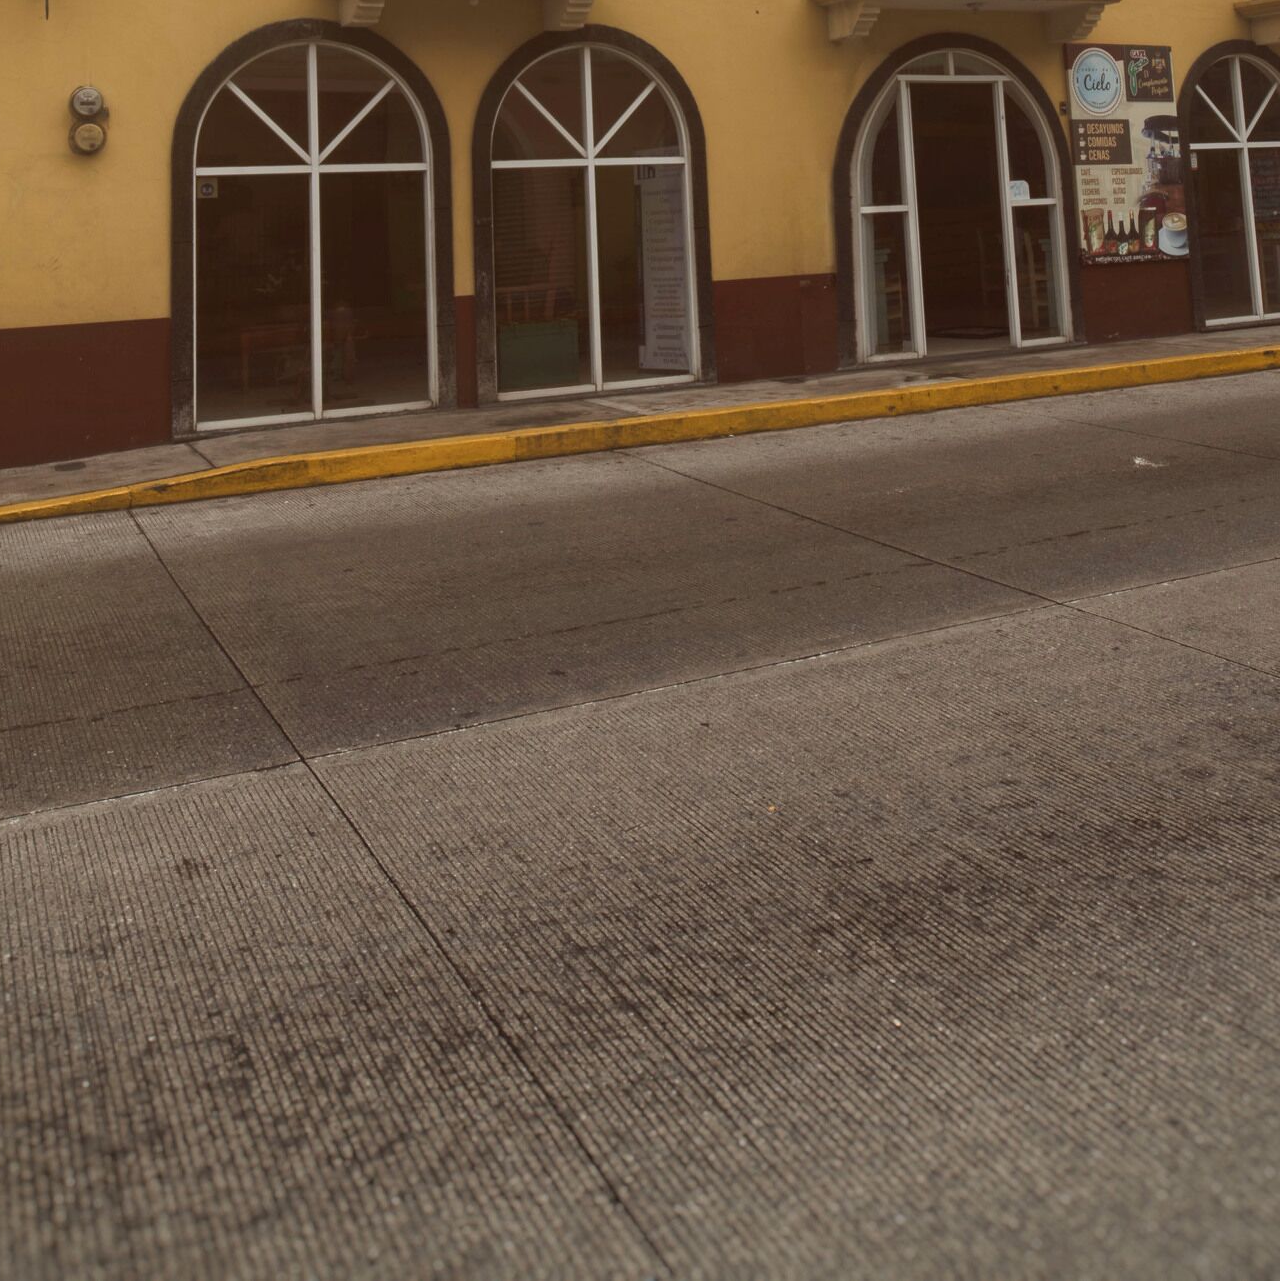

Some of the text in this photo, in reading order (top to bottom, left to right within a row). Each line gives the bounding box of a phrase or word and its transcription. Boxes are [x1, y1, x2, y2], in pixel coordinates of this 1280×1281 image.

[1084, 72, 1111, 92] Cielo
[1087, 124, 1124, 135] DESAYUNOS
[1088, 136, 1117, 147] COMIDAS
[1089, 150, 1111, 160] CENAS
